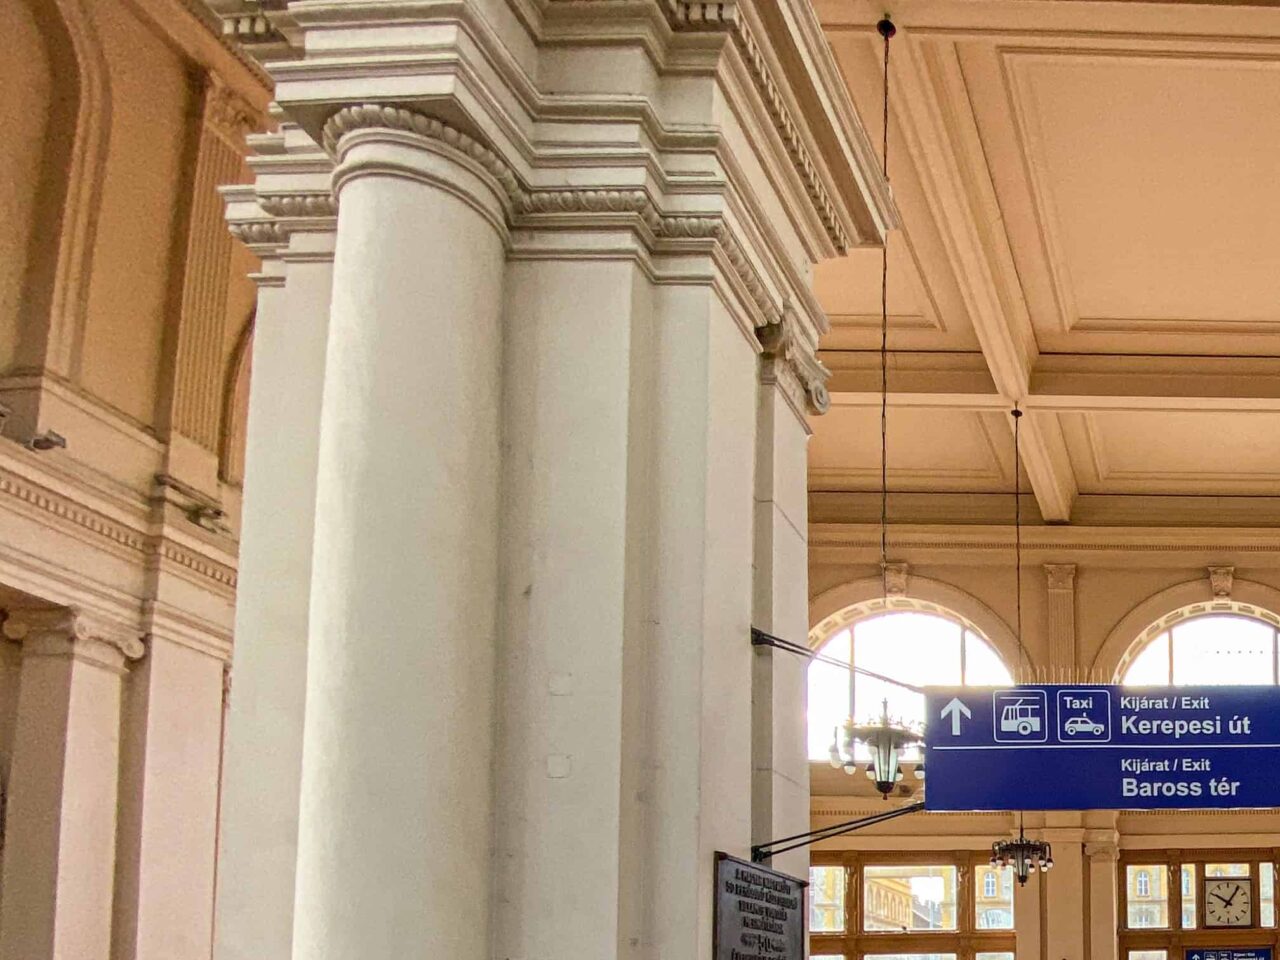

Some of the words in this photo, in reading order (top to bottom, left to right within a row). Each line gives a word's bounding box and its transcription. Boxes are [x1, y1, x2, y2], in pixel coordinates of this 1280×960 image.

[1063, 696, 1093, 709] Taxi
[1120, 696, 1169, 712] Kijárat
[1172, 696, 1177, 709] /
[1181, 696, 1210, 709] Exit
[1121, 715, 1221, 738] Kerepesi
[1228, 715, 1251, 735] út
[1121, 758, 1170, 774] Kijárat
[1172, 758, 1178, 771] /
[1182, 758, 1211, 771] Exit
[1122, 777, 1203, 797] Baross
[1208, 777, 1240, 796] tér
